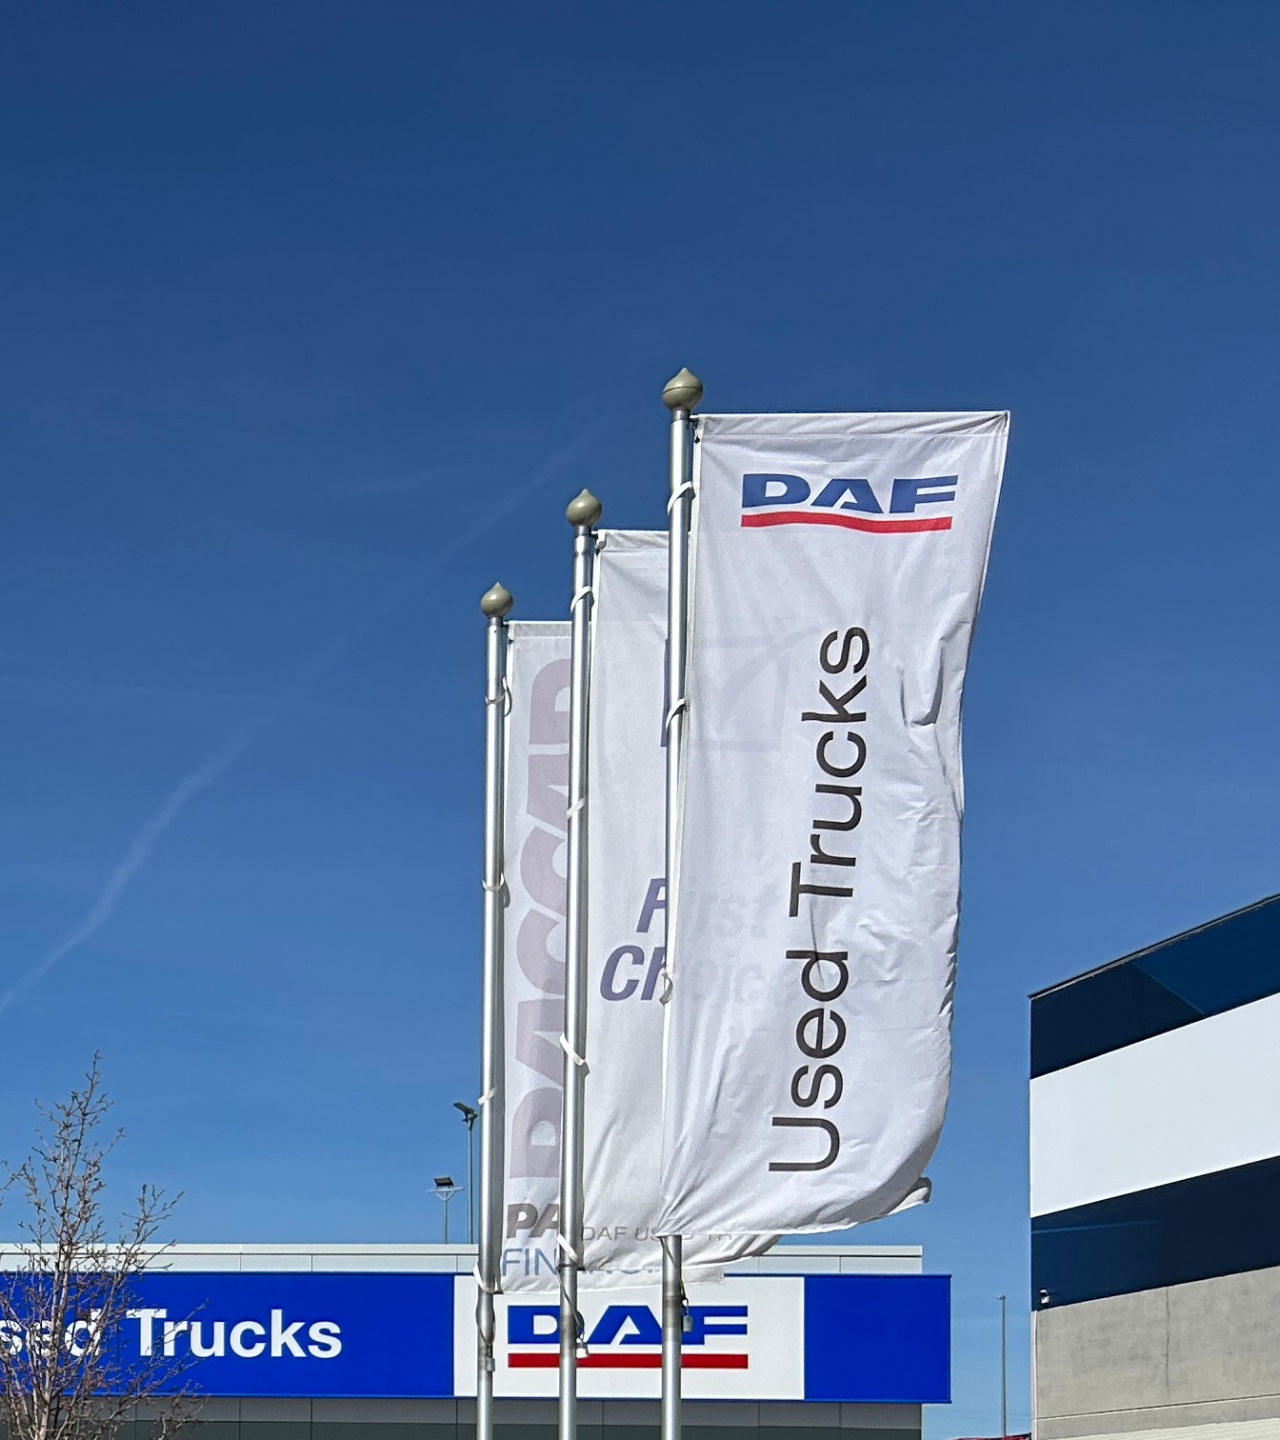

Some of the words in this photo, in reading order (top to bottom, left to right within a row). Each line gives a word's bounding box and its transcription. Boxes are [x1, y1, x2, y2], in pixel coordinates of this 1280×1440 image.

[741, 473, 959, 515] DAF
[789, 626, 871, 918] Trucks
[768, 949, 849, 1172] Used
[126, 1307, 343, 1359] Trucks
[507, 1304, 749, 1345] DAF
